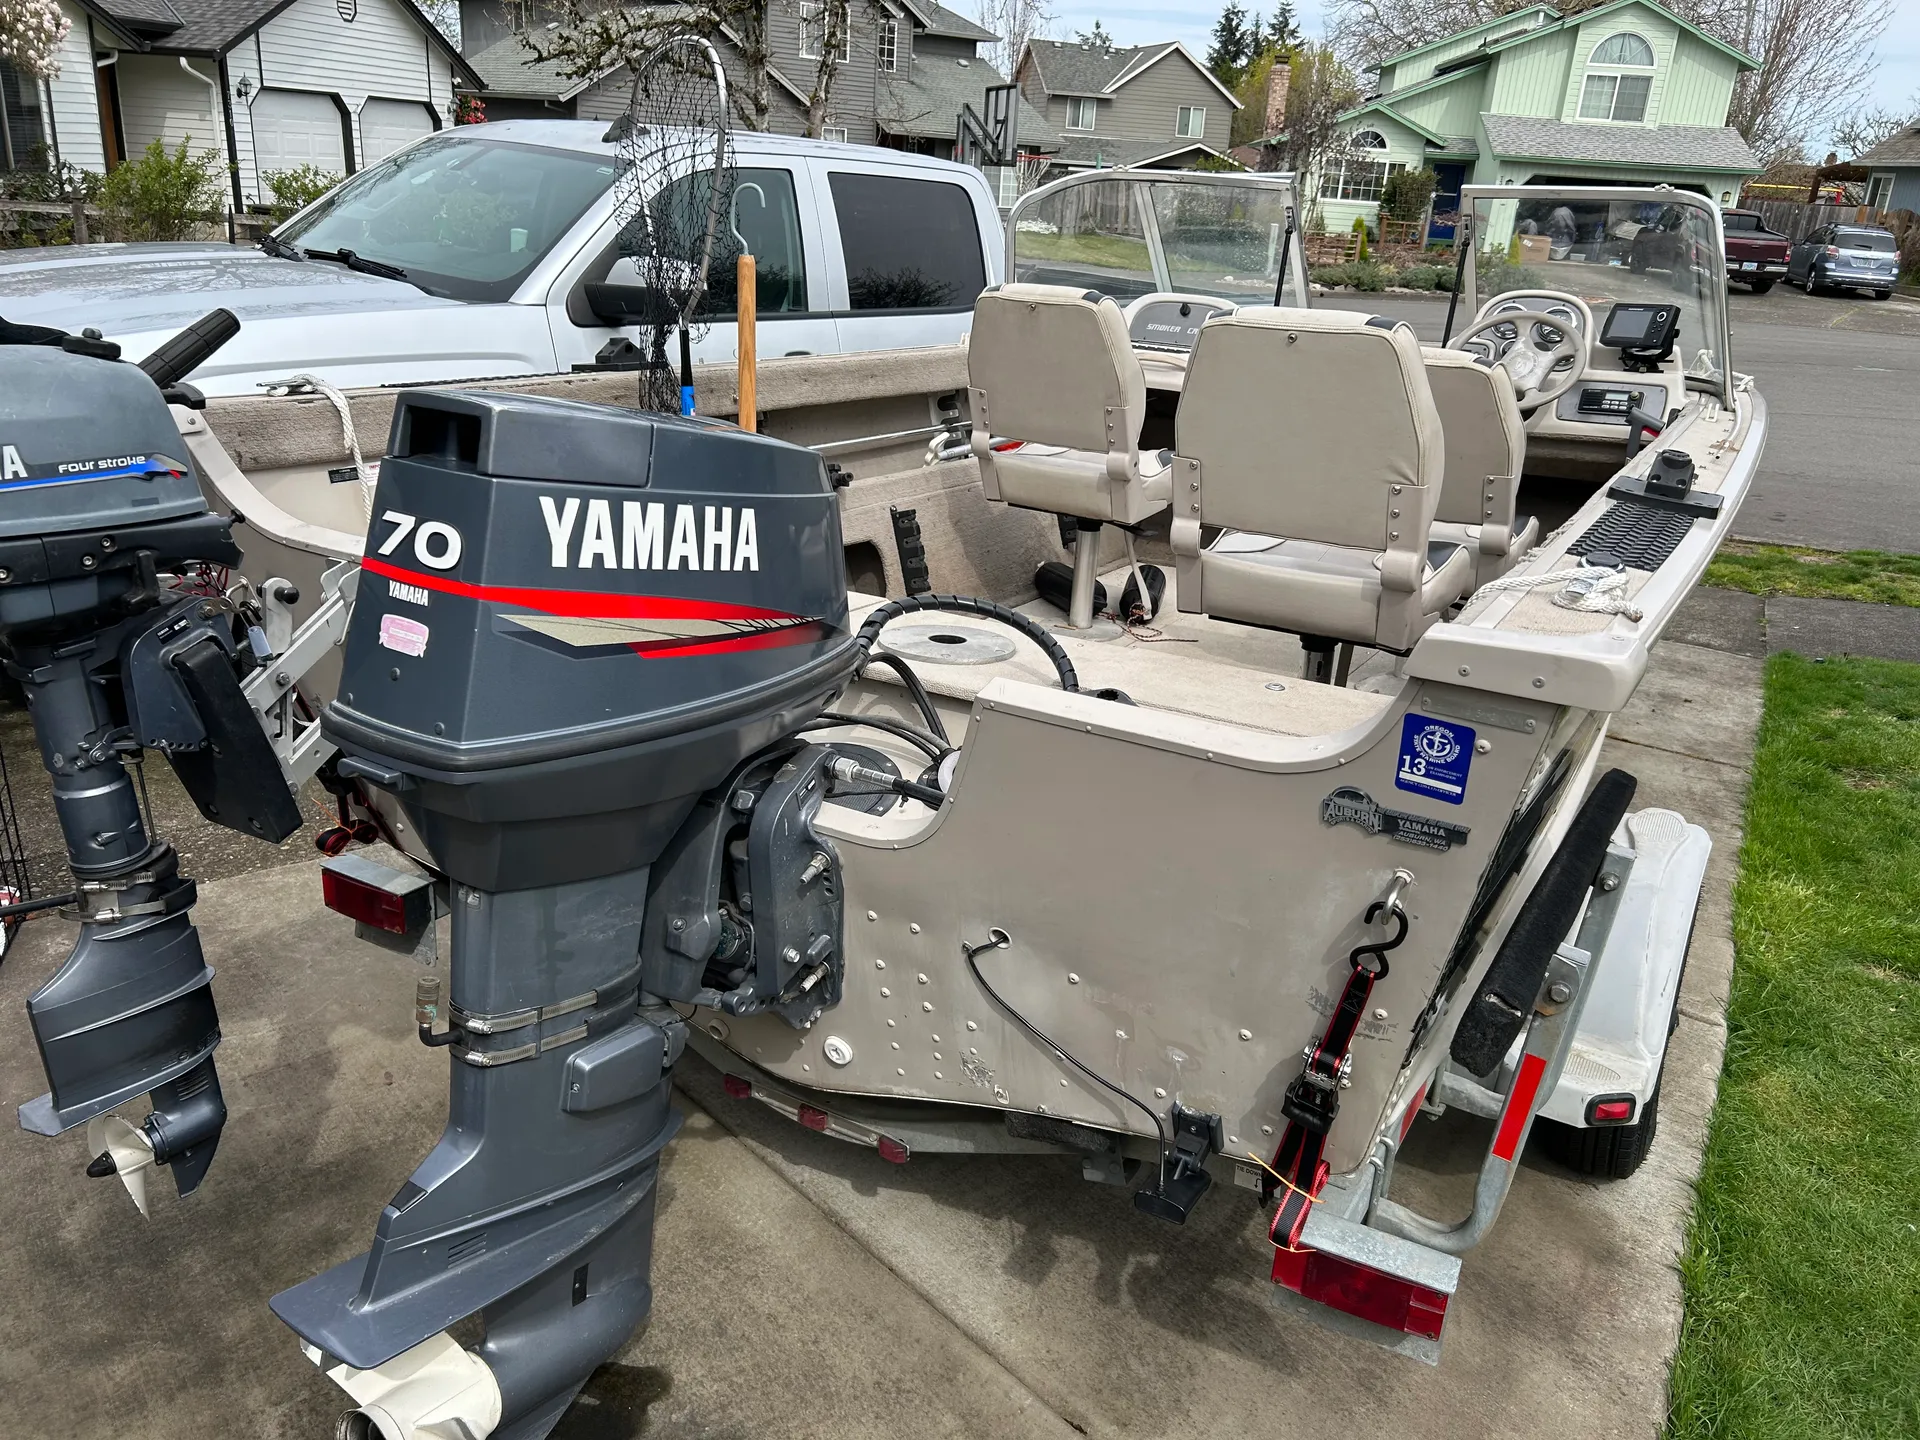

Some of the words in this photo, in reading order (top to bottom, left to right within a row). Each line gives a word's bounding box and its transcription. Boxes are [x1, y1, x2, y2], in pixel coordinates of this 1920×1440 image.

[1146, 323, 1182, 333] SMOKER
[1187, 327, 1199, 335] CR
[0, 445, 28, 480] A
[377, 510, 462, 570] 70
[538, 496, 759, 572] YAMAHA
[388, 579, 429, 607] YAMAHA
[1424, 725, 1454, 738] OREGON
[1413, 734, 1421, 753] STATE
[1420, 752, 1446, 764] MARINE
[1446, 745, 1460, 763] BOARD
[1401, 755, 1426, 776] 13
[1324, 800, 1380, 834] AUBURN
[1397, 819, 1446, 837] YAMAHA
[1398, 831, 1432, 843] AUBURN,
